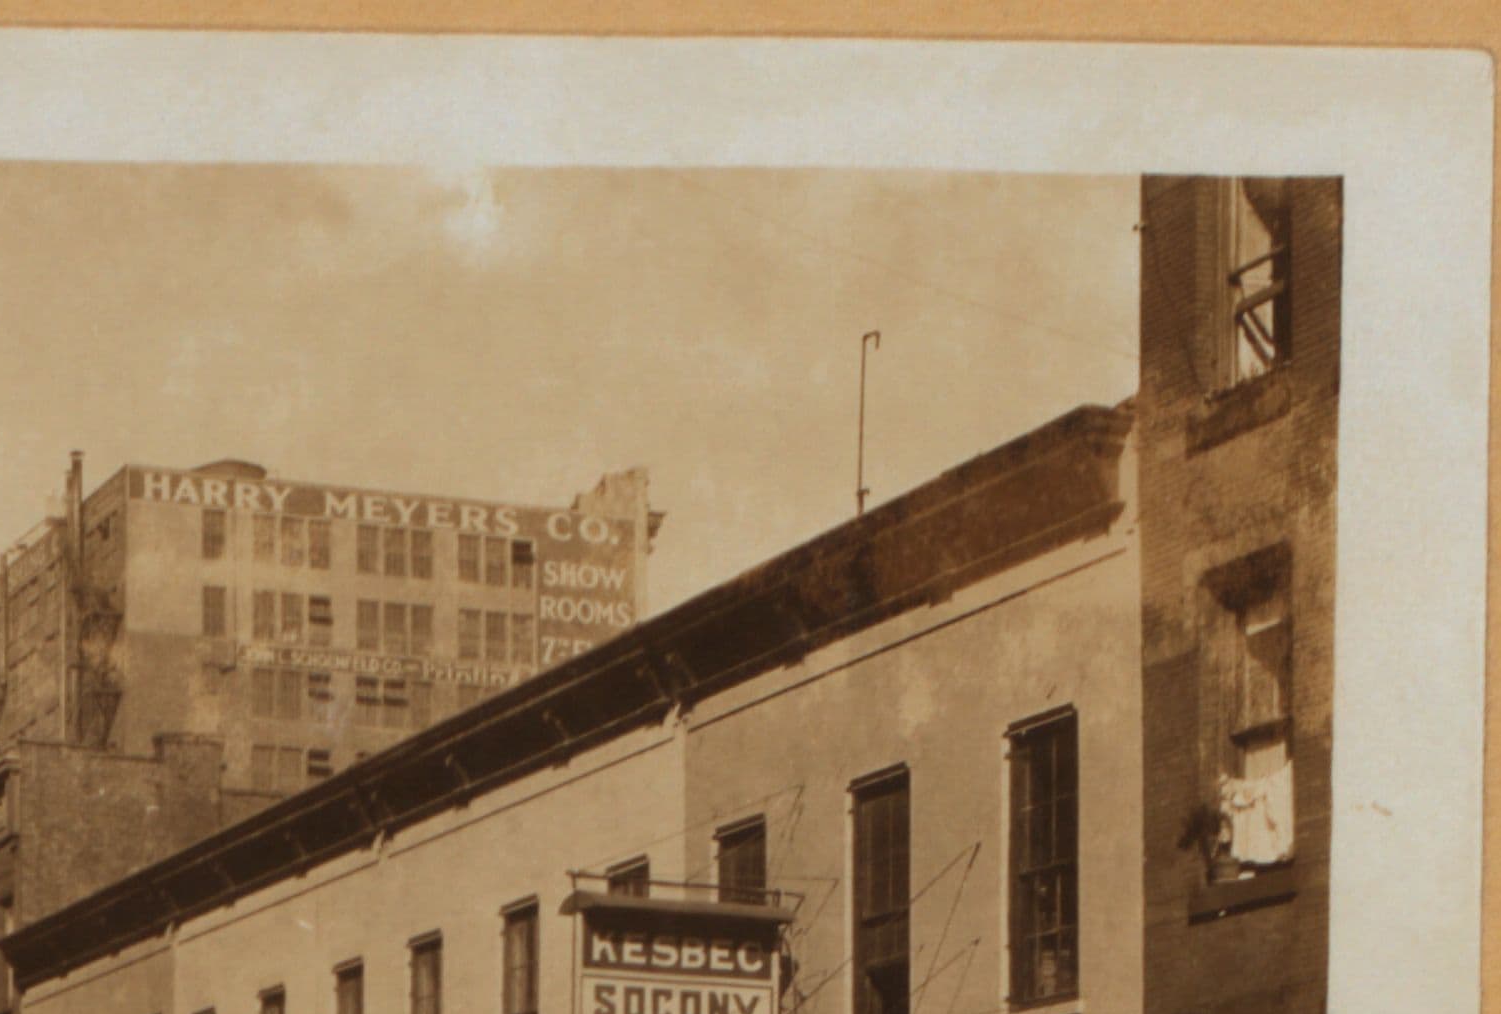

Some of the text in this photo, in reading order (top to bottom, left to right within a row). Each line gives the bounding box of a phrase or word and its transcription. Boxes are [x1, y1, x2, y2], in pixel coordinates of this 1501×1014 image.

[142, 472, 621, 546] HARRY MEYERS CO.
[543, 560, 627, 590] SHOW
[540, 595, 632, 628] ROOMS
[591, 932, 764, 972] KESBEC
